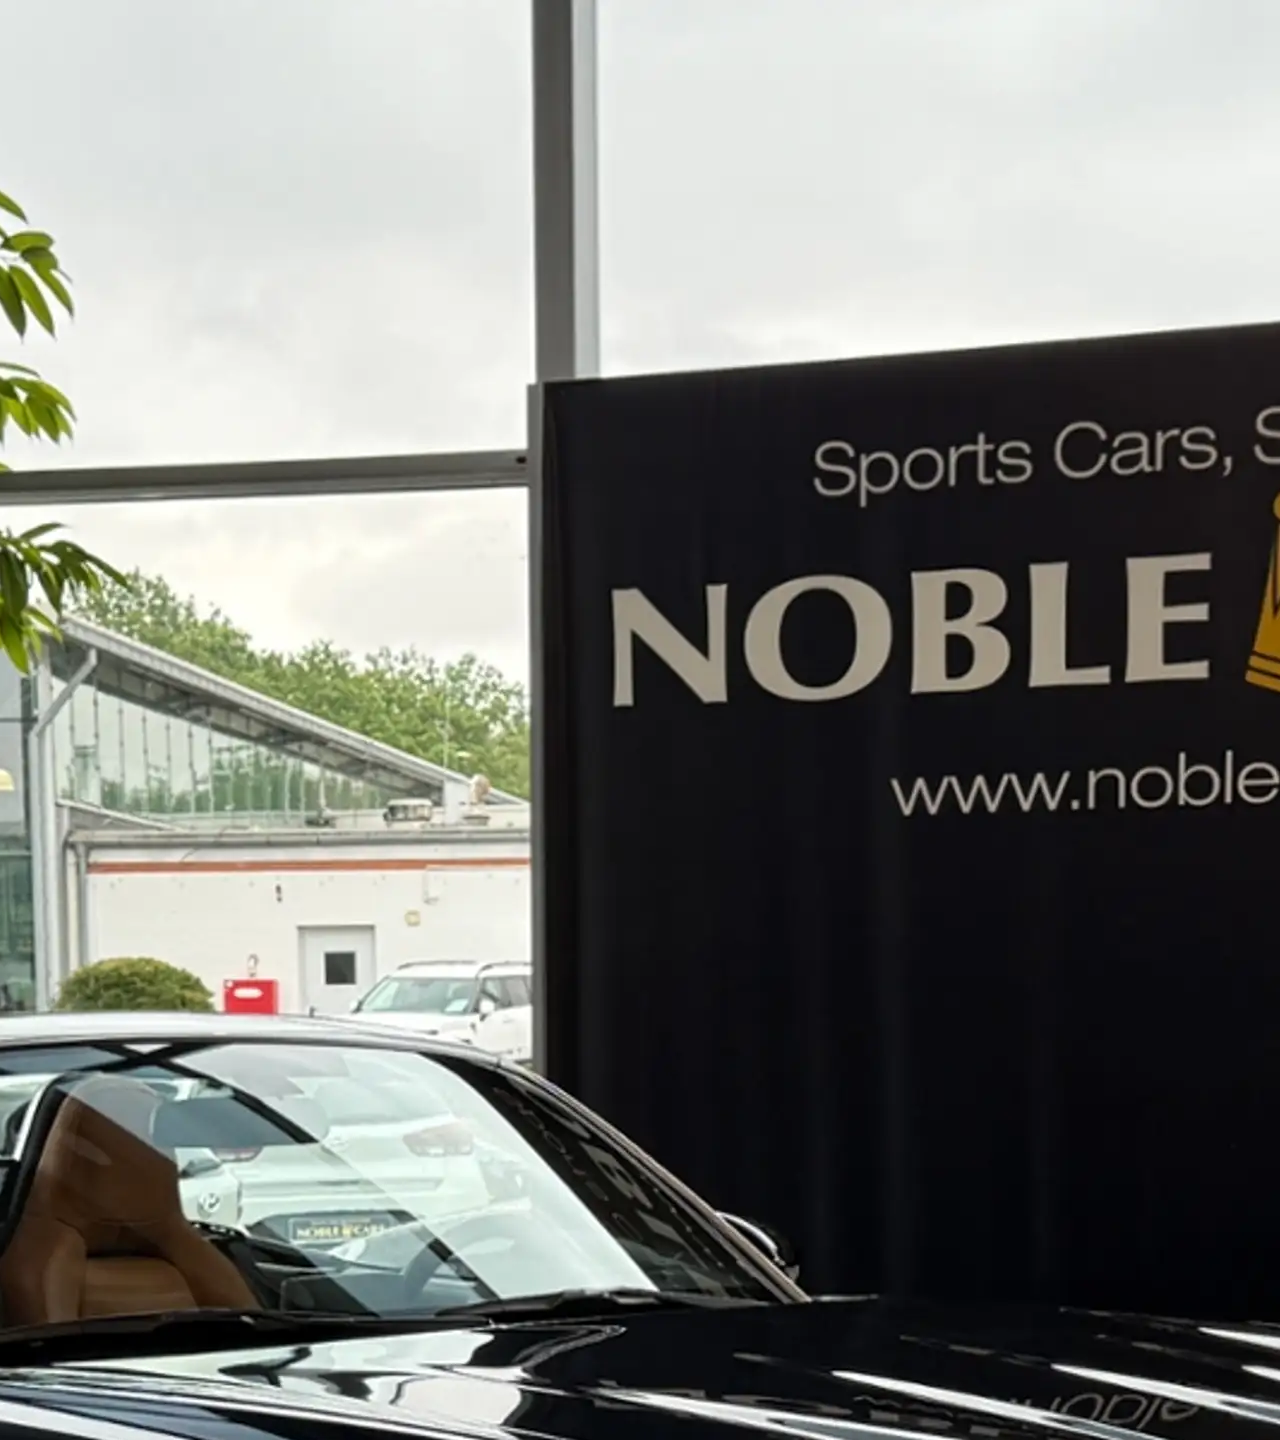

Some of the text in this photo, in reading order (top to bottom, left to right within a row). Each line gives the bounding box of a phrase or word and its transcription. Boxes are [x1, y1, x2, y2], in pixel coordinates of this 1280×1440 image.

[813, 432, 1034, 508] Sports
[1054, 421, 1233, 480] Cars,
[612, 552, 1212, 707] NOBLE
